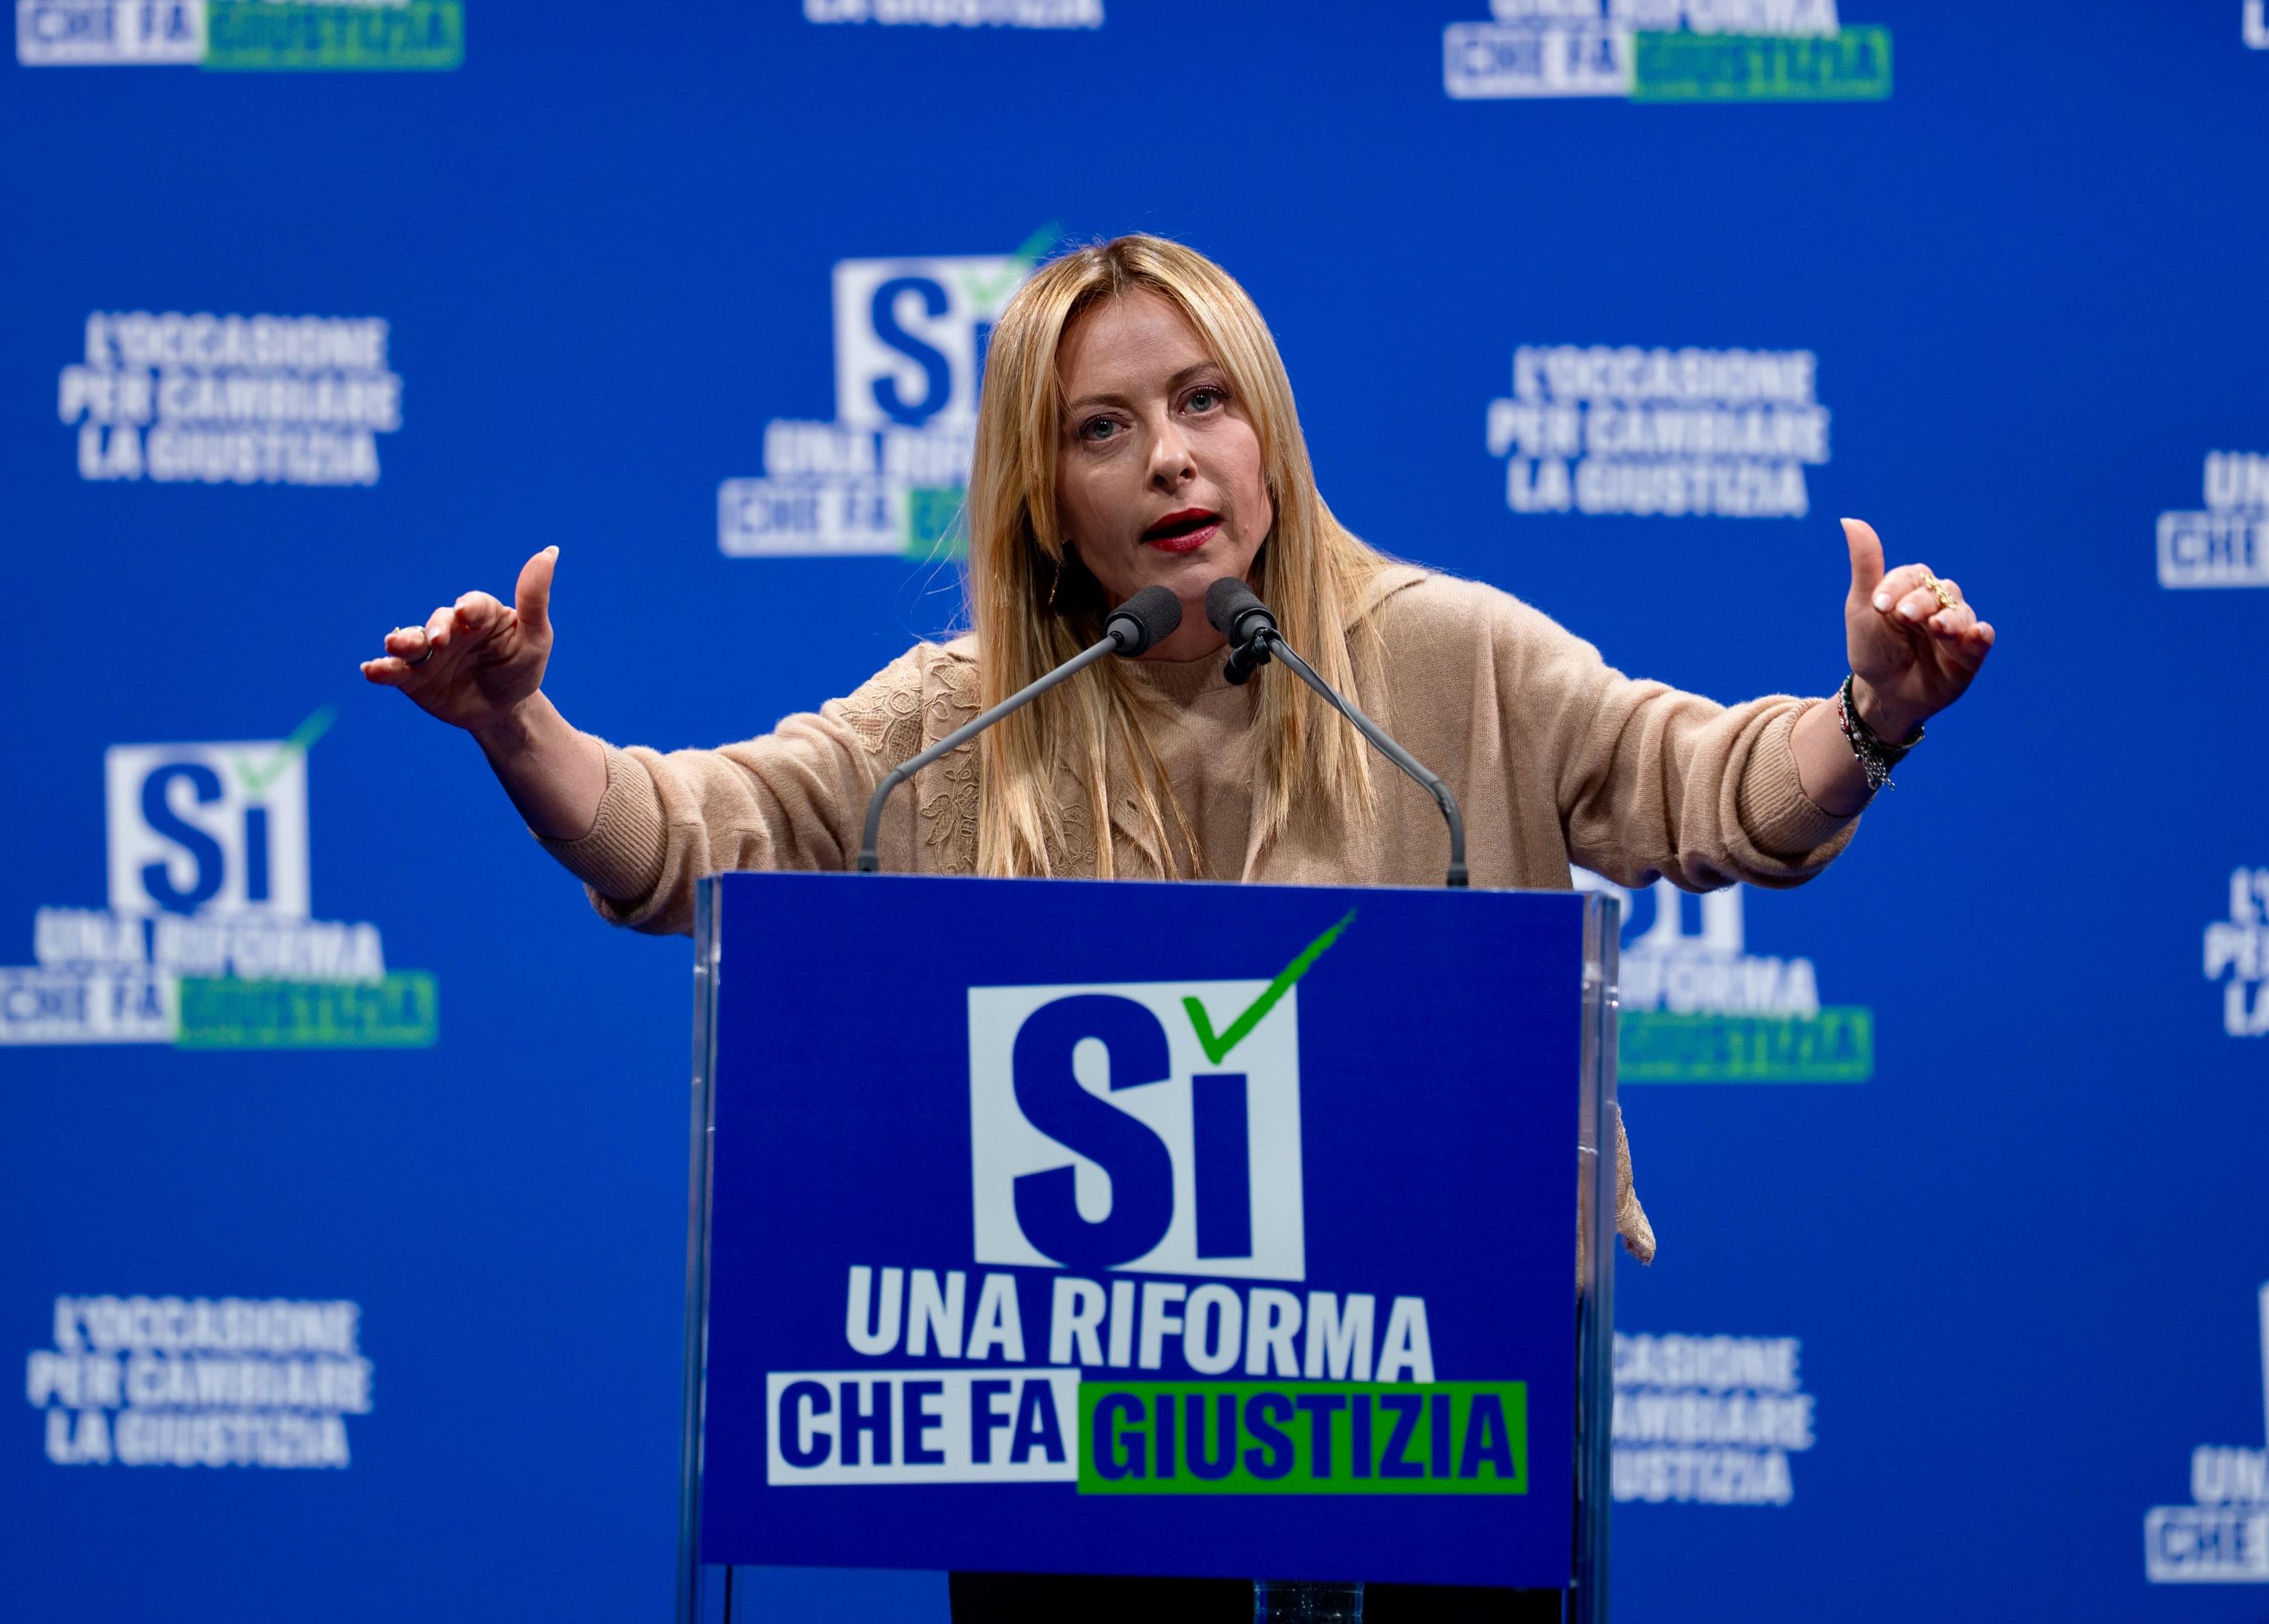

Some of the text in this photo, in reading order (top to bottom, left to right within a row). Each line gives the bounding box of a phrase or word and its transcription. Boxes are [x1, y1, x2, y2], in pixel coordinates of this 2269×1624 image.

[846, 1265, 1435, 1383] UNA RIFORMA
[778, 1378, 1516, 1481] CHE FA GIUSTIZIA
